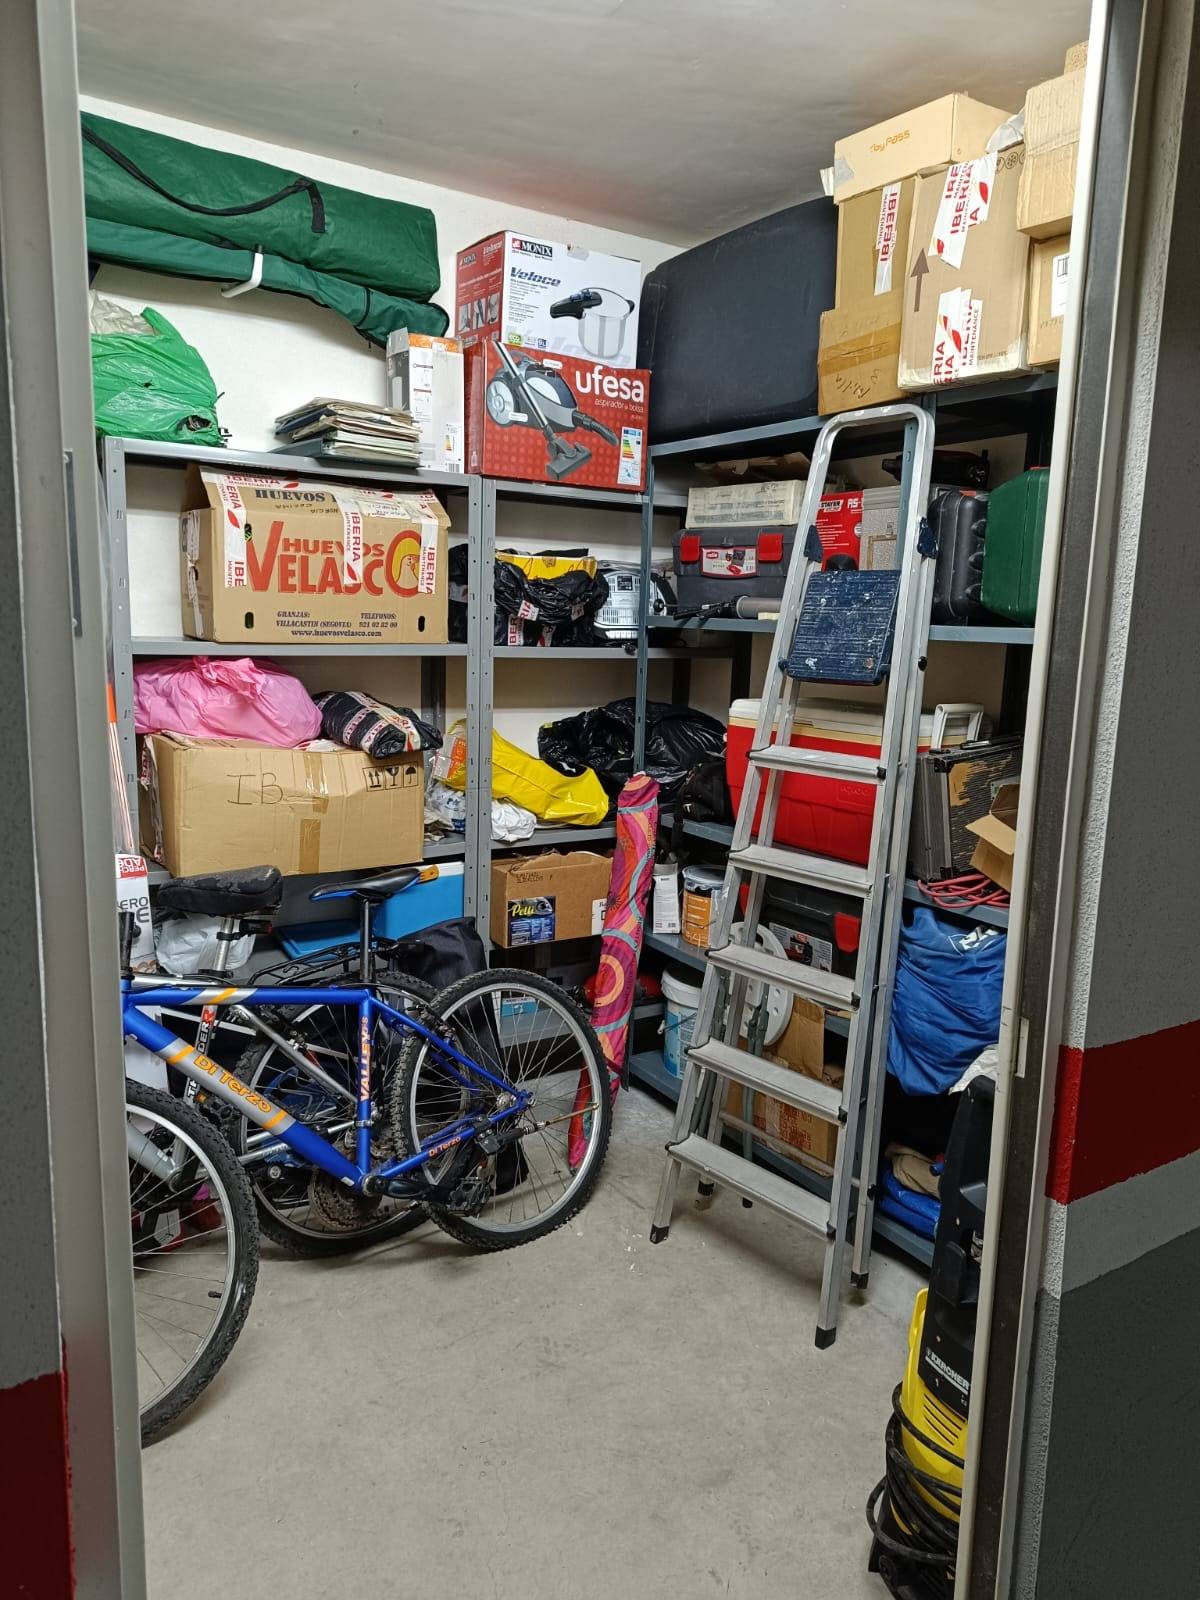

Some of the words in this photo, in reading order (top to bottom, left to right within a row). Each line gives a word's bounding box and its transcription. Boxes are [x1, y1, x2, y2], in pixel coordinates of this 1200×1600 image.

[521, 240, 552, 257] MONIX
[510, 267, 561, 287] Veloce
[575, 366, 645, 403] ufesa
[255, 488, 325, 503] HUEVOS
[350, 512, 361, 562] IBERIA
[425, 546, 436, 596] IBERIA
[290, 629, 382, 637] www.huevosvelasco.com
